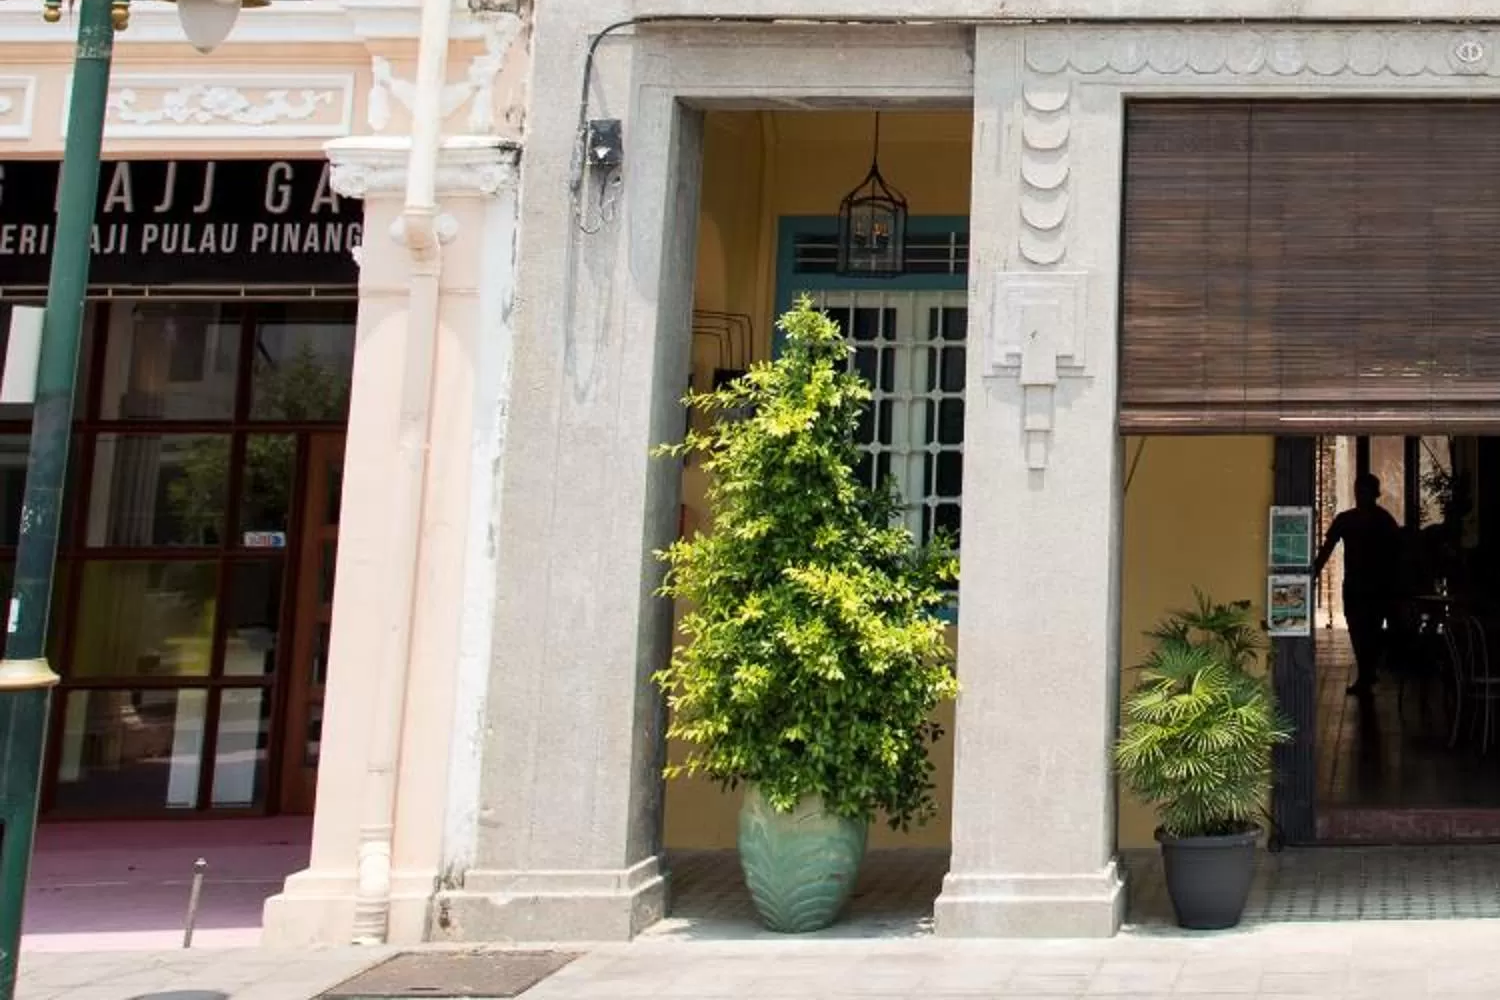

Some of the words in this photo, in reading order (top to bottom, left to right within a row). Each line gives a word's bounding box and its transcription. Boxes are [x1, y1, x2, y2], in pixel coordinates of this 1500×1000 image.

[54, 161, 216, 214] AJJ
[57, 223, 129, 254] AJI
[141, 223, 239, 253] PULAU
[250, 222, 362, 253] PINANG
